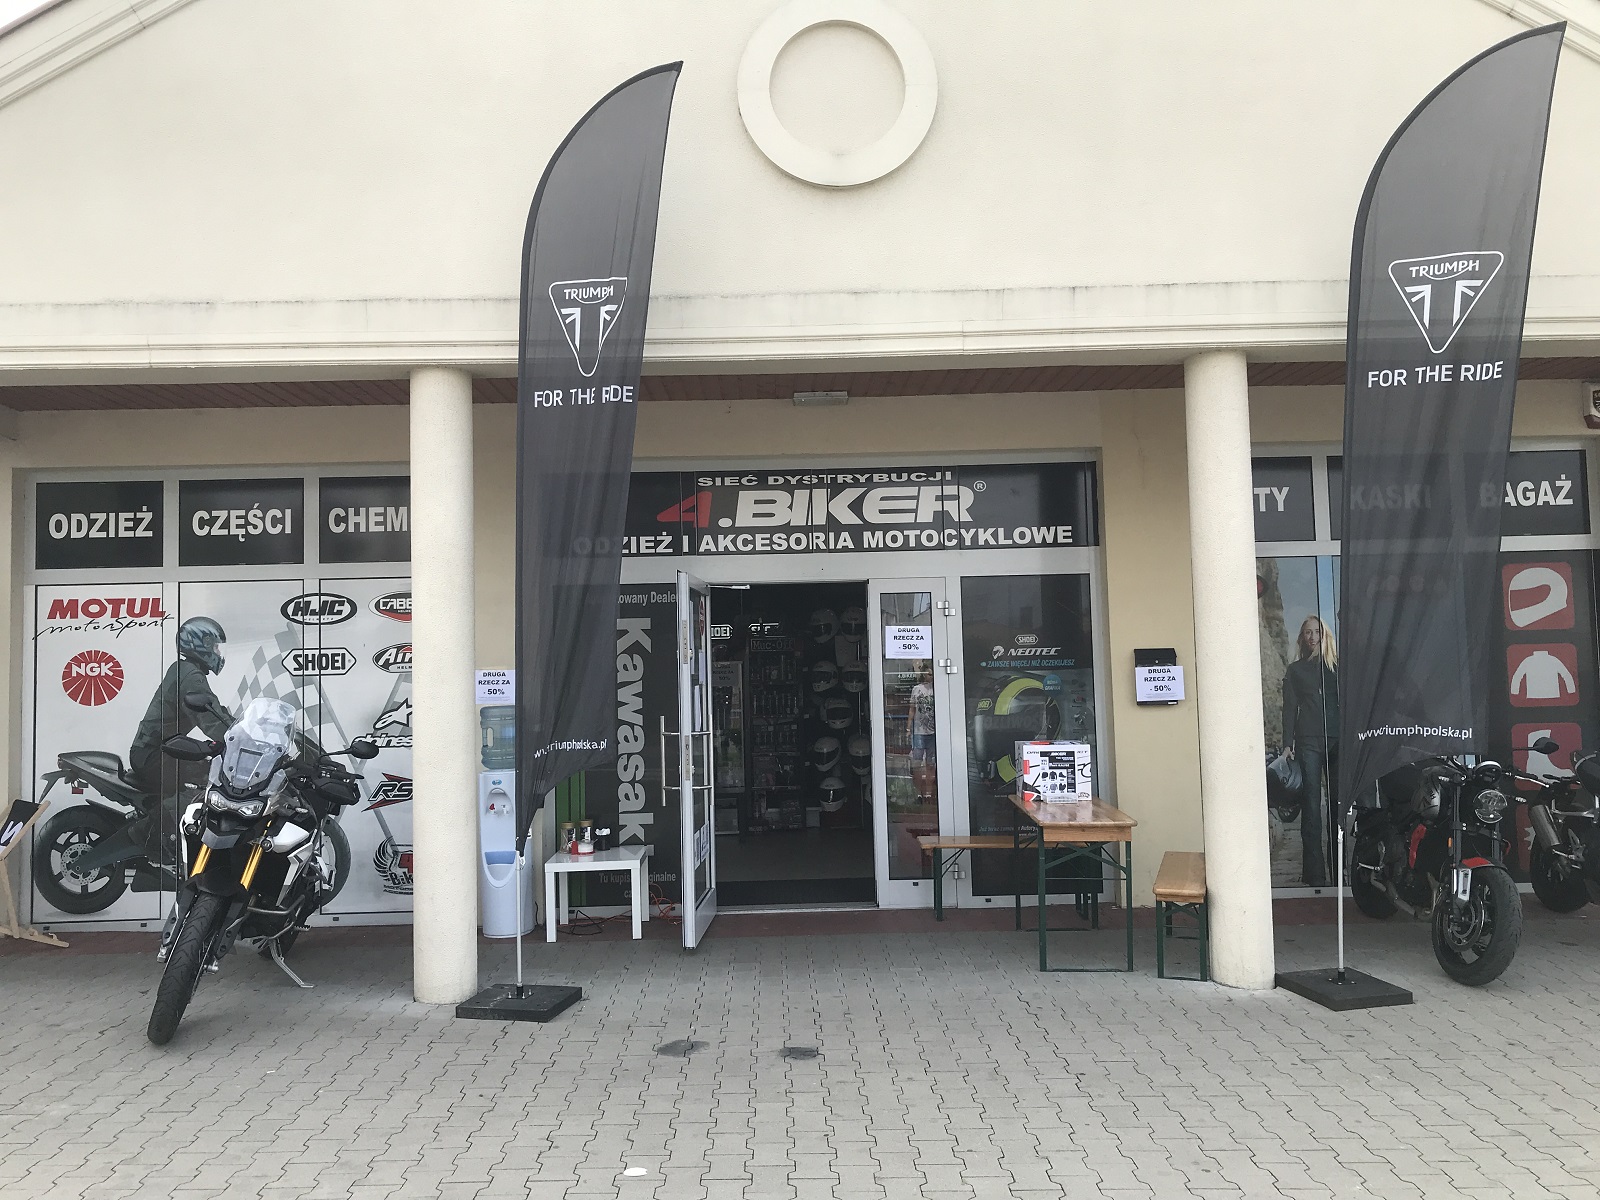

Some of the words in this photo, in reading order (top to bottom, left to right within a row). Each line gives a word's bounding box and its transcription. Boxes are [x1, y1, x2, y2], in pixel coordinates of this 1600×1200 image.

[1409, 260, 1480, 280] TRIUMPH
[564, 285, 614, 303] TRIUMPH
[1368, 369, 1407, 388] FOR
[1415, 364, 1453, 384] THE
[1460, 361, 1504, 381] RIDE
[534, 390, 563, 408] FOR
[570, 387, 596, 405] THE
[602, 385, 634, 404] RDE
[697, 474, 759, 487] SIEĆ
[768, 471, 952, 486] DYSTRYBUCJI
[48, 505, 153, 539] ODZIEŻ
[191, 503, 292, 542] CZĘŚCI
[682, 535, 689, 553] I
[698, 529, 855, 553] AKCESORIA
[863, 525, 1073, 549] MOTOCYKLOWE
[46, 597, 167, 620] MOTUL
[291, 599, 346, 616] HJC
[617, 593, 648, 606] owany
[1008, 647, 1061, 656] NEOTEC
[71, 661, 114, 677] NGK
[293, 652, 347, 672] SHOEI
[610, 871, 632, 885] kupis
